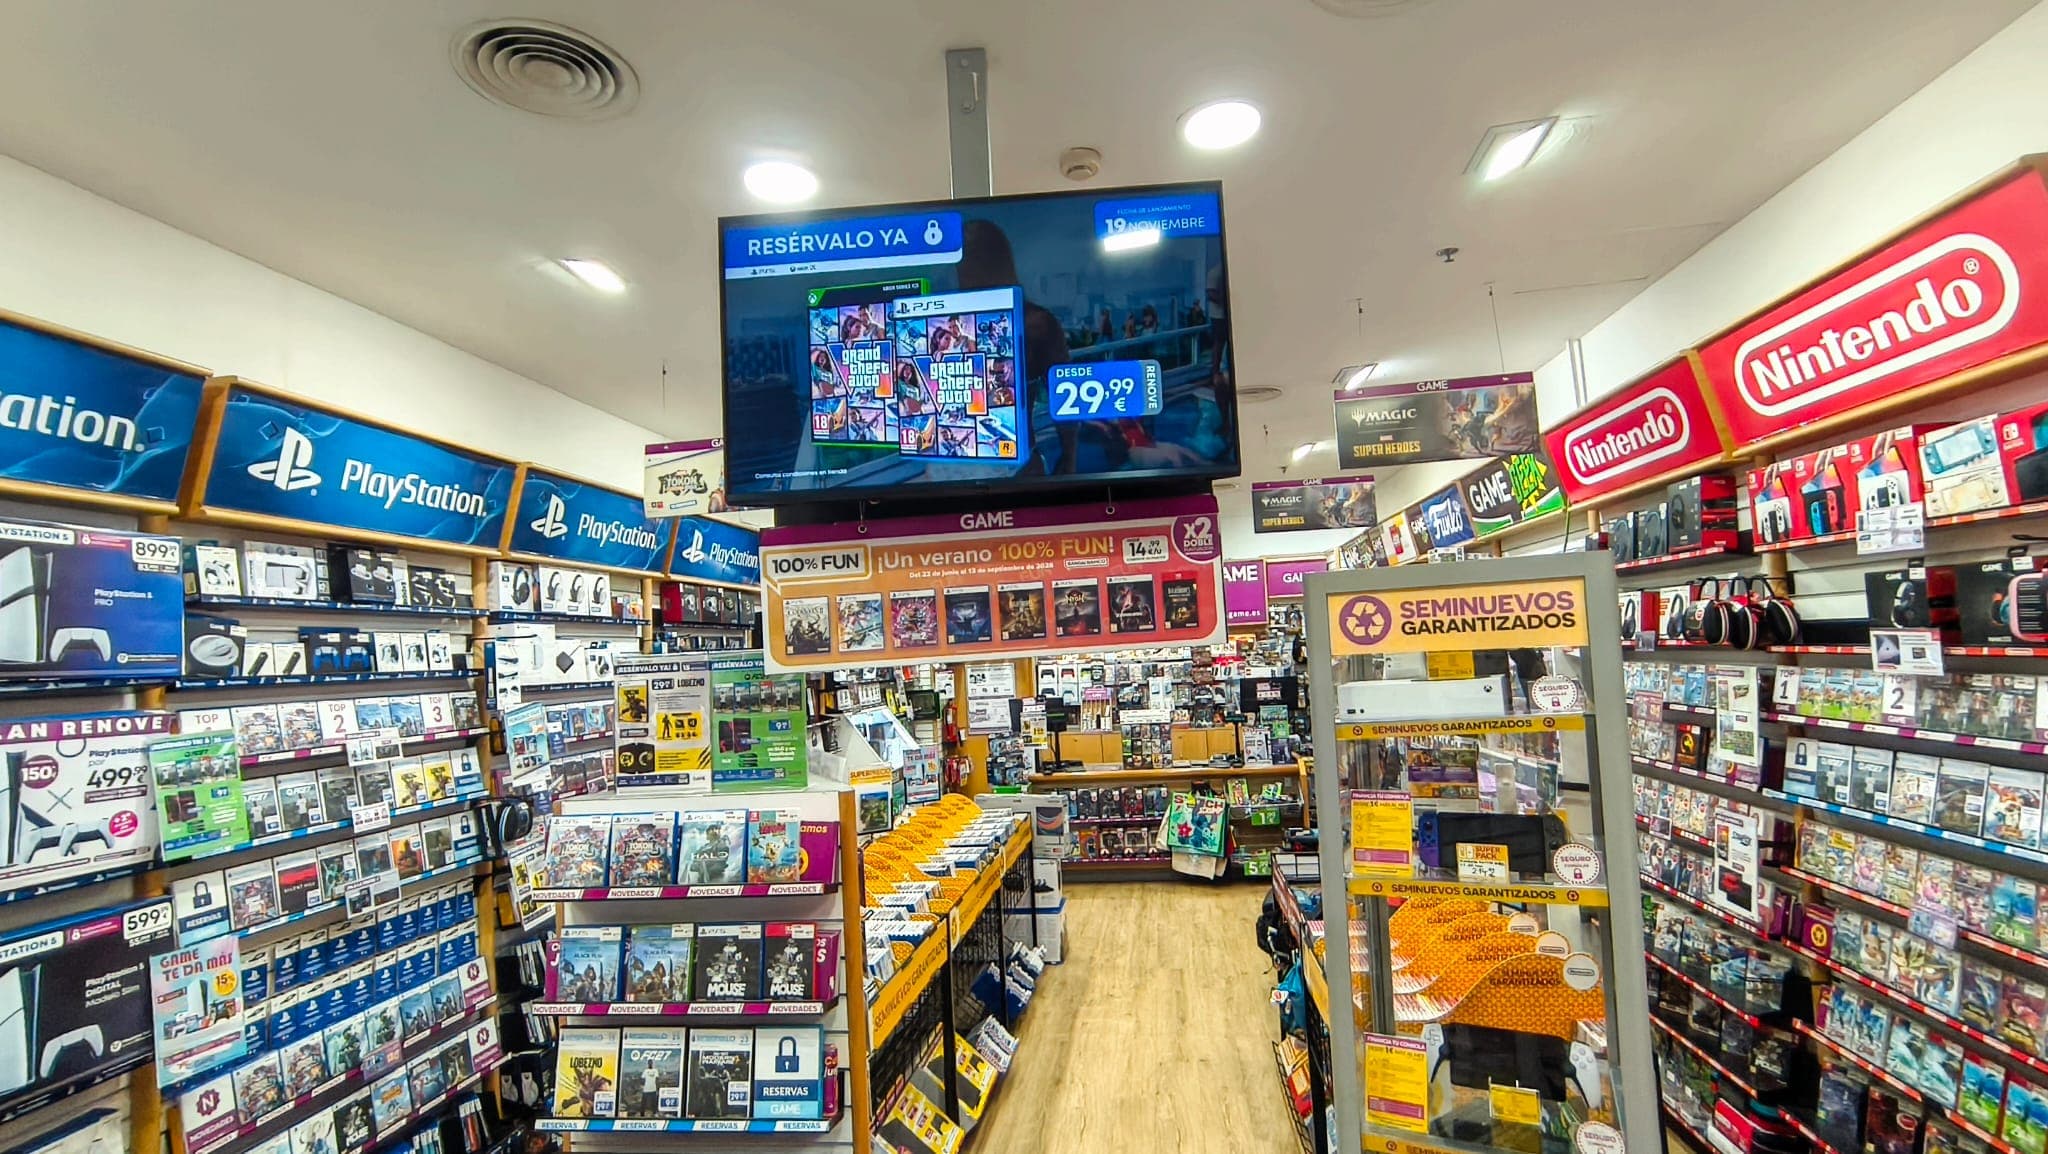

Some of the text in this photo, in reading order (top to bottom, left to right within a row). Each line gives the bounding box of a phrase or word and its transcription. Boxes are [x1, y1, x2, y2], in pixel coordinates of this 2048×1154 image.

[1105, 216, 1206, 233] 19 NOVIEMBRE
[748, 228, 909, 256] RESÉRVALO YA
[912, 300, 945, 311] PS5
[1750, 276, 1982, 398] Nintendo
[842, 346, 881, 364] grand
[850, 360, 889, 376] theft
[930, 361, 972, 380] grand
[1056, 366, 1093, 378] DESDE
[848, 374, 880, 387] auto
[938, 375, 983, 391] theft
[1146, 365, 1158, 409] RENOVE
[1416, 380, 1449, 391] GAME
[937, 389, 972, 404] auto
[814, 415, 828, 430] 18
[1366, 408, 1418, 422] MAGIC
[901, 429, 915, 445] 18
[1573, 407, 1676, 472] Nintendo
[1353, 440, 1421, 457] SUPER HEROES
[341, 459, 488, 518] PlayStation
[1302, 478, 1323, 486] GAME
[1469, 470, 1513, 513] GAME
[1270, 495, 1303, 505] MAGIC
[960, 510, 1014, 530] GAME
[1262, 516, 1305, 527] SUPER HEROES
[1428, 497, 1463, 540] Funko
[577, 512, 657, 551] PlayStation
[877, 535, 1115, 574] ¡Un verano 100% FUN!
[771, 553, 859, 575] 100% FUN
[987, 565, 1025, 575] septiembre
[1283, 572, 1303, 583] GA
[1400, 590, 1575, 620] SEMINUEVOS
[1228, 610, 1261, 619] game.es
[1401, 612, 1576, 636] GARANTIZADOS
[1779, 679, 1788, 700] 1
[1890, 687, 1905, 710] 2
[328, 703, 346, 713] TOP
[432, 706, 443, 723] 3
[195, 714, 219, 725] TOP
[332, 715, 346, 733] 2
[1372, 718, 1532, 735] SEMINUEVOS GARANTIZADOS
[0, 716, 163, 740] AN RENOVE
[690, 852, 730, 861] HALO
[1560, 855, 1592, 863] SEGURO
[531, 885, 817, 899] NOVEDADES NOVEDADES NOVEDADES NOVEDADES
[1391, 883, 1556, 900] SEMINUEVOS GARANTIZADOS
[160, 948, 199, 969] GAME
[162, 951, 233, 982] TE DA MÁS
[707, 982, 746, 996] MOUSE
[770, 981, 805, 996] MOUSE
[533, 1003, 818, 1014] NOVEDADES NOVEDADES NOVEDADES NOVEDADES
[569, 1056, 603, 1069] LOBEZNO
[639, 1050, 670, 1060] FC27
[762, 1085, 809, 1096] RESERVAS
[770, 1103, 801, 1115] GAME
[541, 1120, 821, 1130] RESERVAS RESERVAS RESERVAS RESERVAS
[1584, 1132, 1617, 1144] SEGURO
